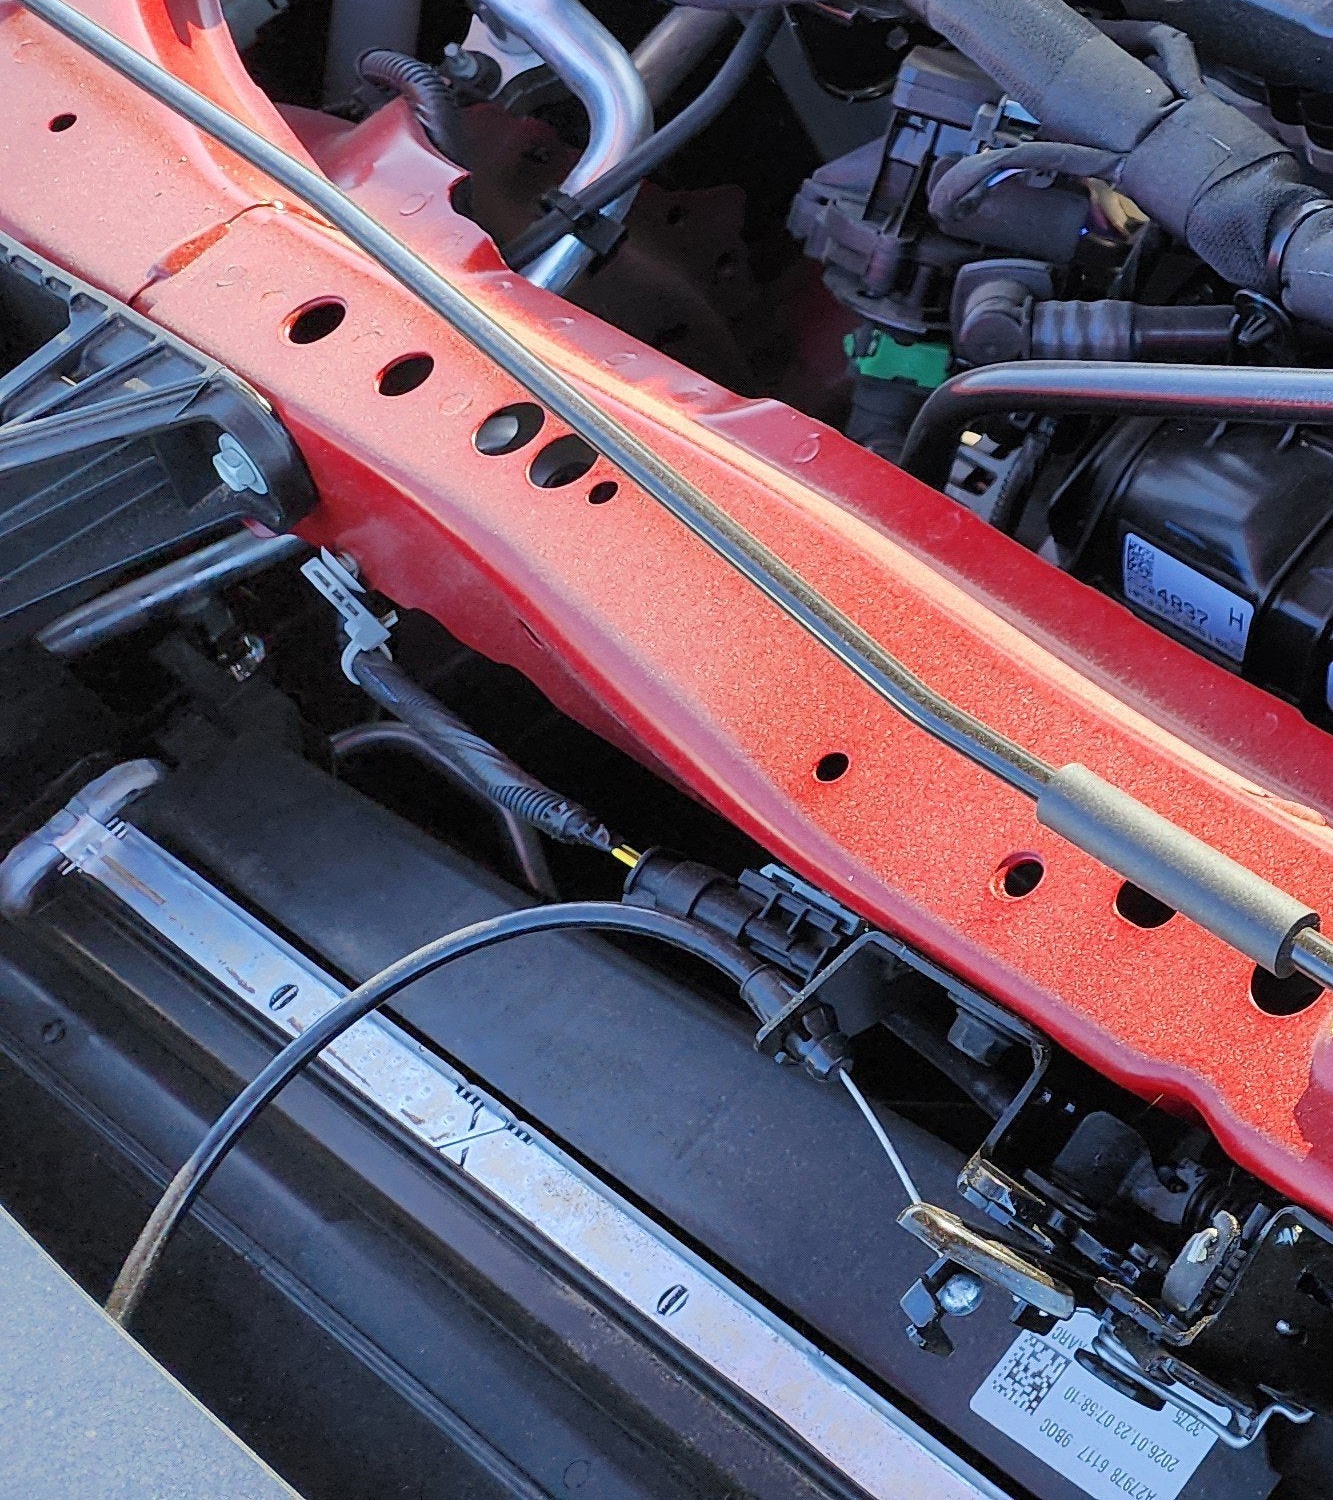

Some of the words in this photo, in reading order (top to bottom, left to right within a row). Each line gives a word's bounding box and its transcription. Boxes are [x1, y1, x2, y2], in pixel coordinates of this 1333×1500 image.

[1230, 607, 1244, 631] H
[1063, 1385, 1115, 1428] 07:58:10
[1173, 1409, 1204, 1436] 3275
[1076, 1444, 1109, 1472] 6117
[1113, 1420, 1179, 1472] 2026.01.23
